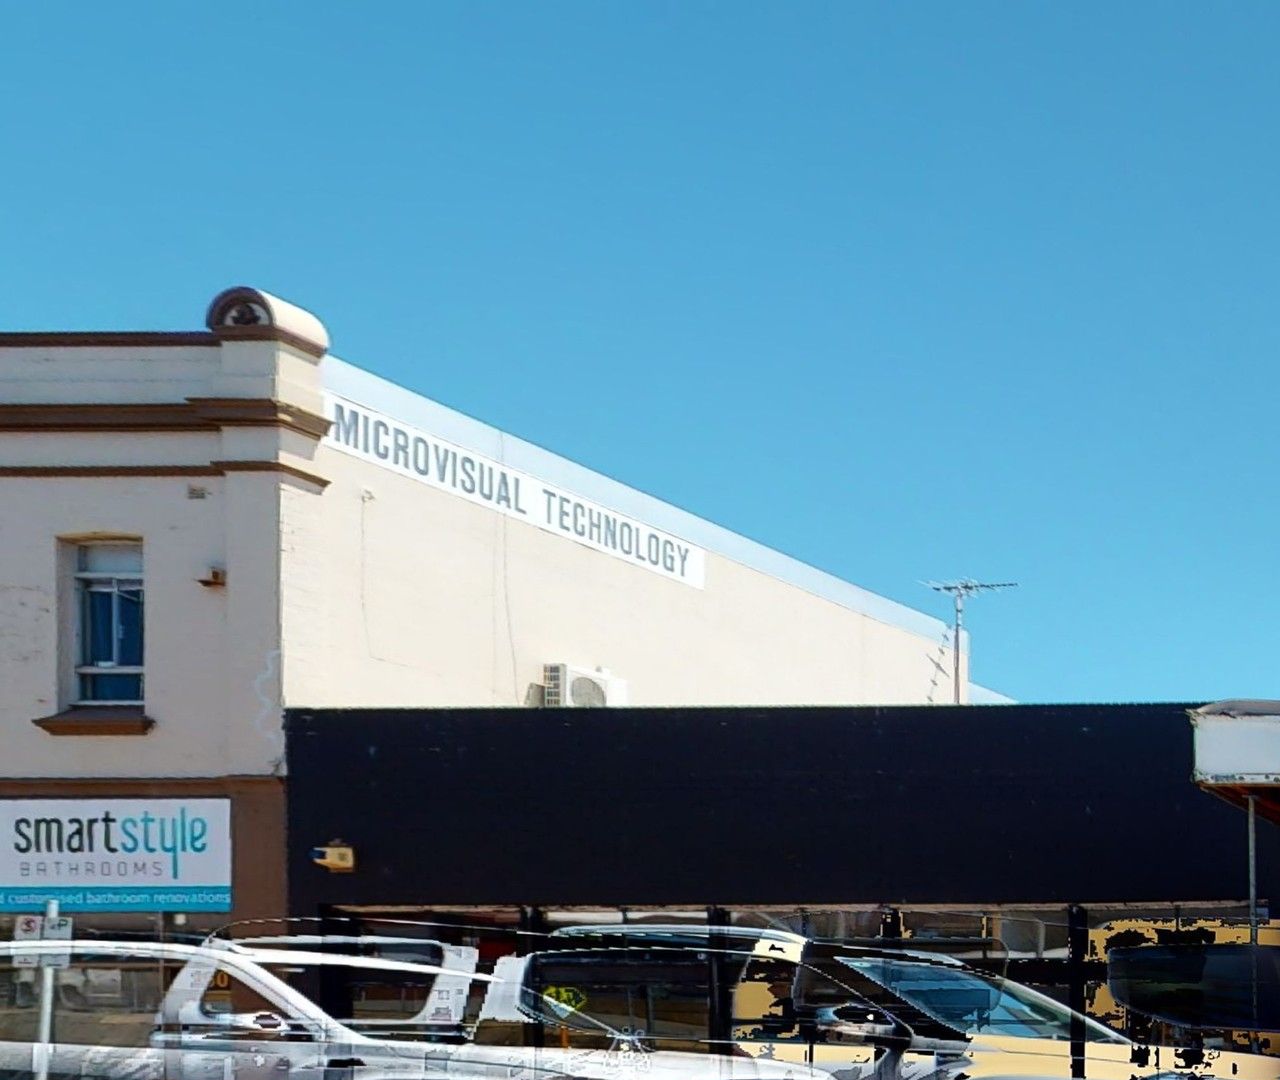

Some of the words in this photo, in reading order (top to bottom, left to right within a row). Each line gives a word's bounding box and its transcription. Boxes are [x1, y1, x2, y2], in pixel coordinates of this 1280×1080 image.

[334, 403, 527, 515] MICROVISUAL
[542, 488, 690, 578] TECHNOLOGY
[14, 807, 208, 879] smartstyle
[20, 861, 164, 877] BATHROOMS
[86, 890, 150, 904] bathroom
[153, 891, 231, 905] renovations
